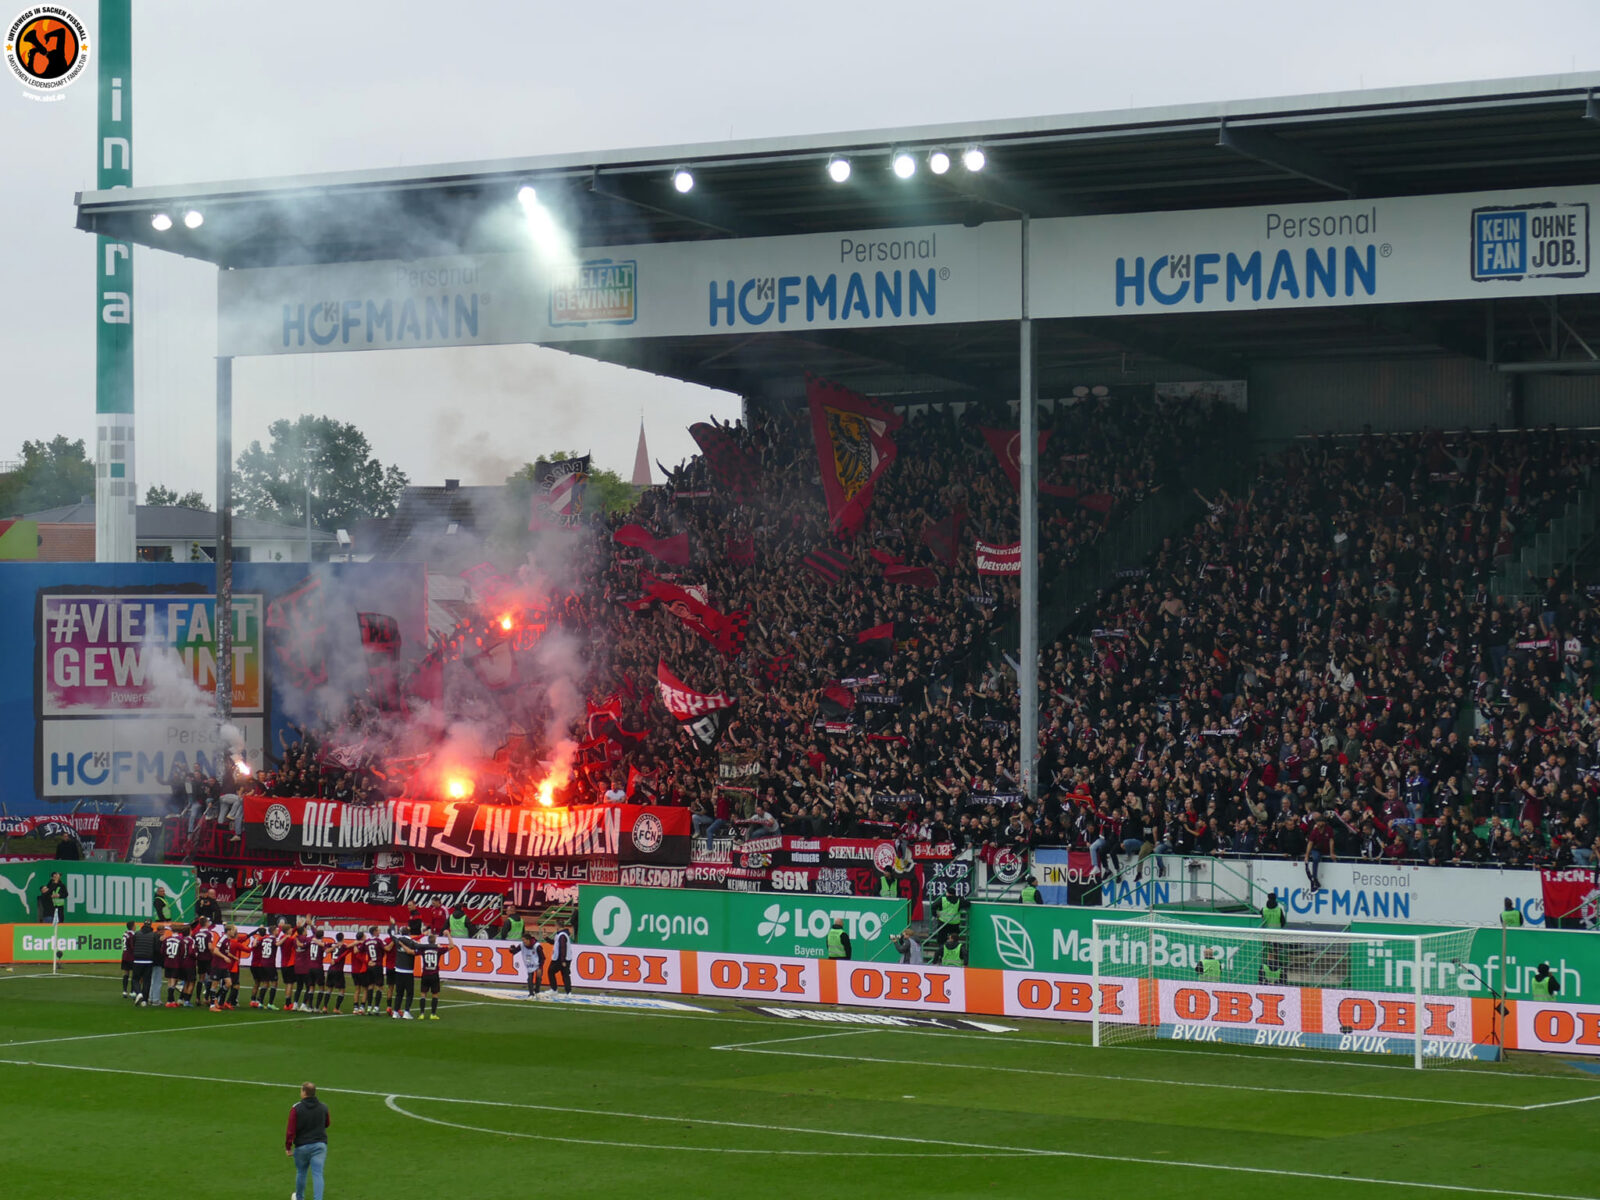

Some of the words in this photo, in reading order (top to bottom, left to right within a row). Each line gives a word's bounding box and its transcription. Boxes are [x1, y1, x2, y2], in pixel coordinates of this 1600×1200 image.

[102, 77, 131, 325] inra
[1266, 207, 1376, 239] Personal
[1480, 216, 1520, 242] KEIN
[1531, 214, 1577, 238] OHNE
[841, 233, 937, 263] Personal
[1481, 242, 1521, 271] FAN
[1532, 239, 1581, 267] JOB.
[396, 260, 479, 289] Personal
[1115, 244, 1376, 307] HOFMANN
[555, 288, 632, 312] GEWINNT
[709, 268, 936, 327] HOFMANN
[282, 294, 479, 348] HOFMANN
[51, 603, 254, 643] #VIELFAT
[269, 819, 285, 830] FCN
[302, 801, 338, 848] DIE
[338, 799, 431, 849] NUMMER
[431, 802, 480, 858] 1
[483, 807, 511, 854] IN
[514, 807, 622, 857] FRANKEN
[639, 830, 657, 842] FCN
[620, 867, 686, 888] ADELSDORF
[695, 867, 716, 881] RSR
[771, 870, 809, 891] SGN
[933, 863, 968, 878] RED
[1043, 867, 1097, 885] PINOLA
[1352, 871, 1410, 887] Personal
[67, 873, 153, 917] PUMA
[1274, 886, 1410, 919] HOFMANN
[637, 913, 709, 940] signia
[794, 908, 882, 941] LOTTO
[166, 942, 179, 956] 20
[794, 944, 824, 957] Bayern
[576, 951, 668, 985] OBI
[709, 959, 805, 994] OBI
[850, 968, 950, 1004] OBI
[1017, 978, 1123, 1015] OBI
[1173, 987, 1285, 1026] OBI
[1337, 997, 1455, 1037] OBI
